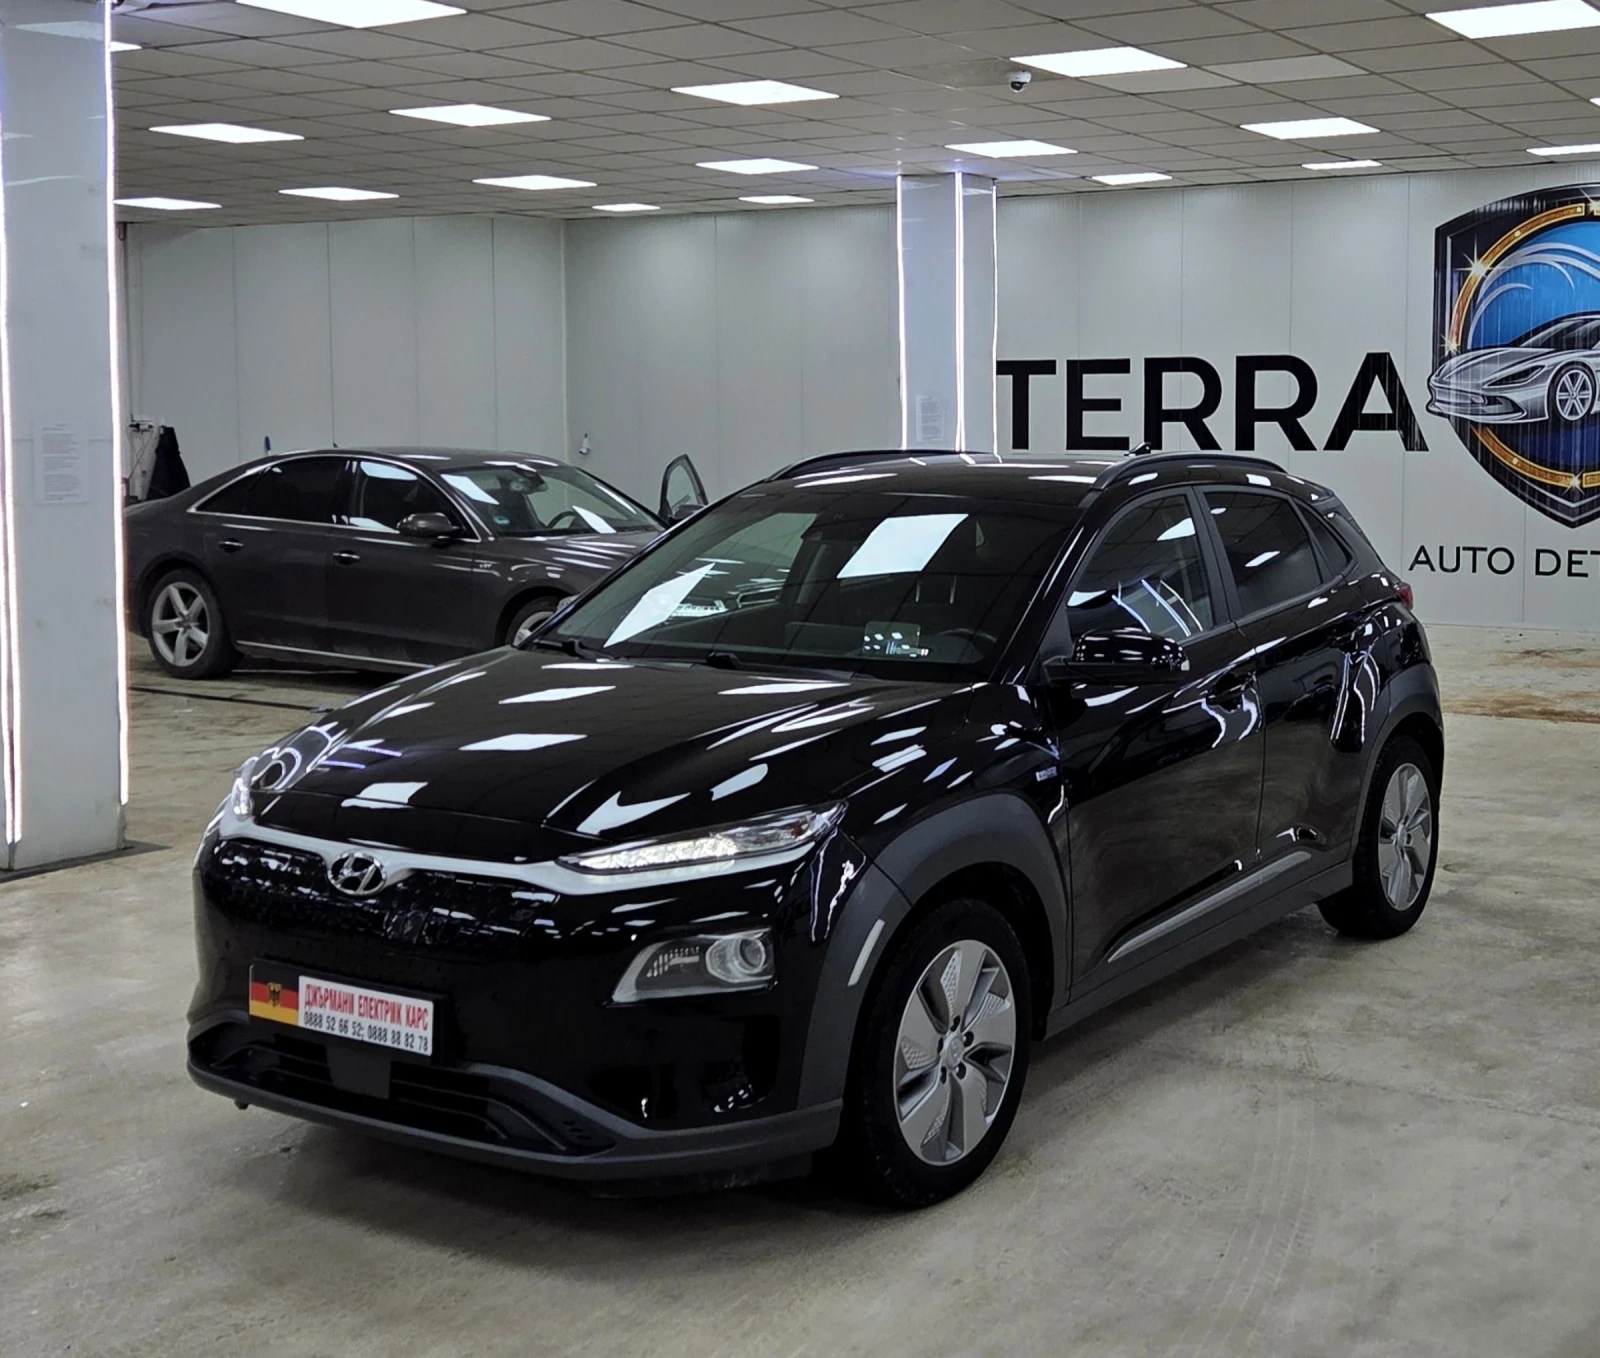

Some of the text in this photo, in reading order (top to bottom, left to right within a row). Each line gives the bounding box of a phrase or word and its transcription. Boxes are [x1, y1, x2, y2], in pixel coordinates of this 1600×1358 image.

[996, 352, 1429, 452] TERRA
[1408, 545, 1515, 575] AUTO
[304, 984, 429, 1031] ДЖЪРМАНИ ЕЛЕКТРИК КАРС
[304, 1011, 323, 1028] 0888
[326, 1015, 336, 1031] 52
[367, 1024, 388, 1043] 0888
